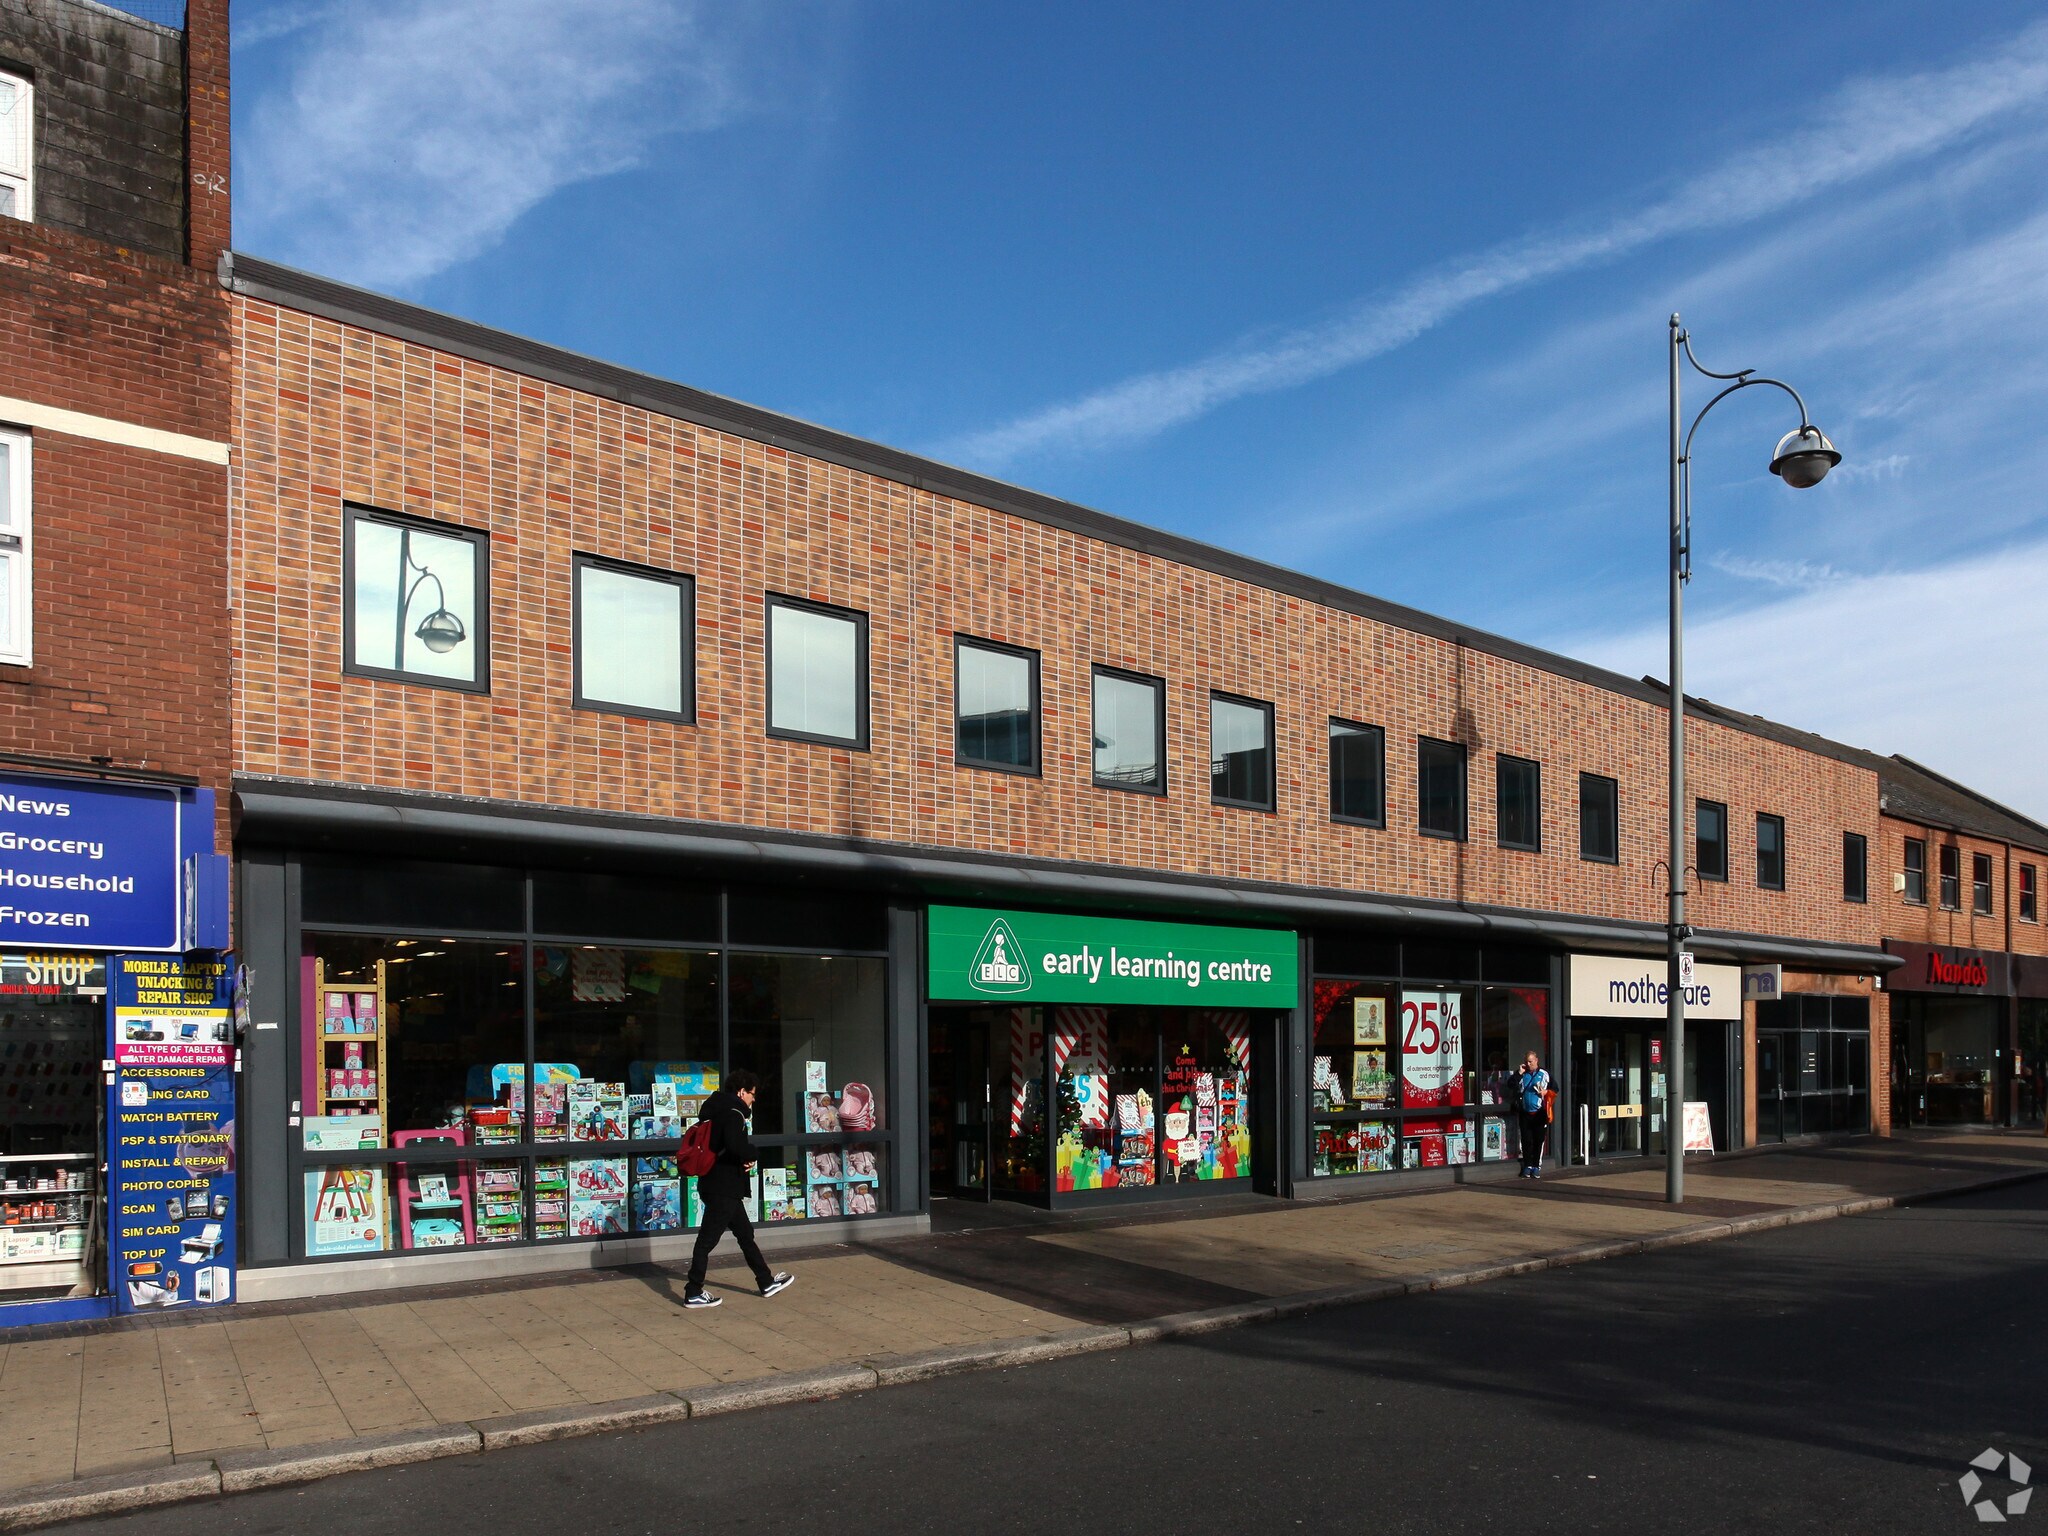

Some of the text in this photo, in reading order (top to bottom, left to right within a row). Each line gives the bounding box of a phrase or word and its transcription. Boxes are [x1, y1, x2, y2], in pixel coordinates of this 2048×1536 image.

[0, 794, 70, 817] News
[0, 831, 104, 859] Grocery
[0, 868, 134, 894] Household
[0, 906, 90, 927] Frozen
[25, 952, 95, 986] SHOP
[123, 960, 227, 976] MOBILE & LAPTOP
[982, 964, 1019, 981] ELC
[1042, 945, 1272, 988] early learning centre
[1931, 951, 1988, 986] Nando's
[137, 975, 215, 990] UNLOCKING &
[0, 984, 61, 995] WHILE YOU WAIT
[1609, 974, 1711, 1006] motheare
[137, 990, 214, 1005] REPAIR SHOP
[141, 1008, 168, 1016] WHILE
[128, 1045, 224, 1054] ALL TYPE OF TABLET &
[1441, 1035, 1459, 1055] off
[133, 1055, 156, 1063] ATER
[157, 1055, 194, 1063] DAMAGE
[1176, 1056, 1196, 1065] Come
[120, 1068, 206, 1077] ACCESSORIES
[667, 1064, 690, 1072] FREE
[1168, 1067, 1183, 1080] and
[669, 1074, 692, 1085] Toys
[176, 1090, 210, 1099] CARD
[121, 1112, 219, 1122] WATCH BATTERY
[121, 1134, 231, 1146] PSP & STATIONARY
[121, 1156, 227, 1169] INSTALL & REPAIR
[122, 1178, 210, 1191] PHOTO COPIES
[122, 1204, 156, 1214] SCAN
[122, 1225, 181, 1238] SIM CARD
[122, 1248, 167, 1260] TOP UP
